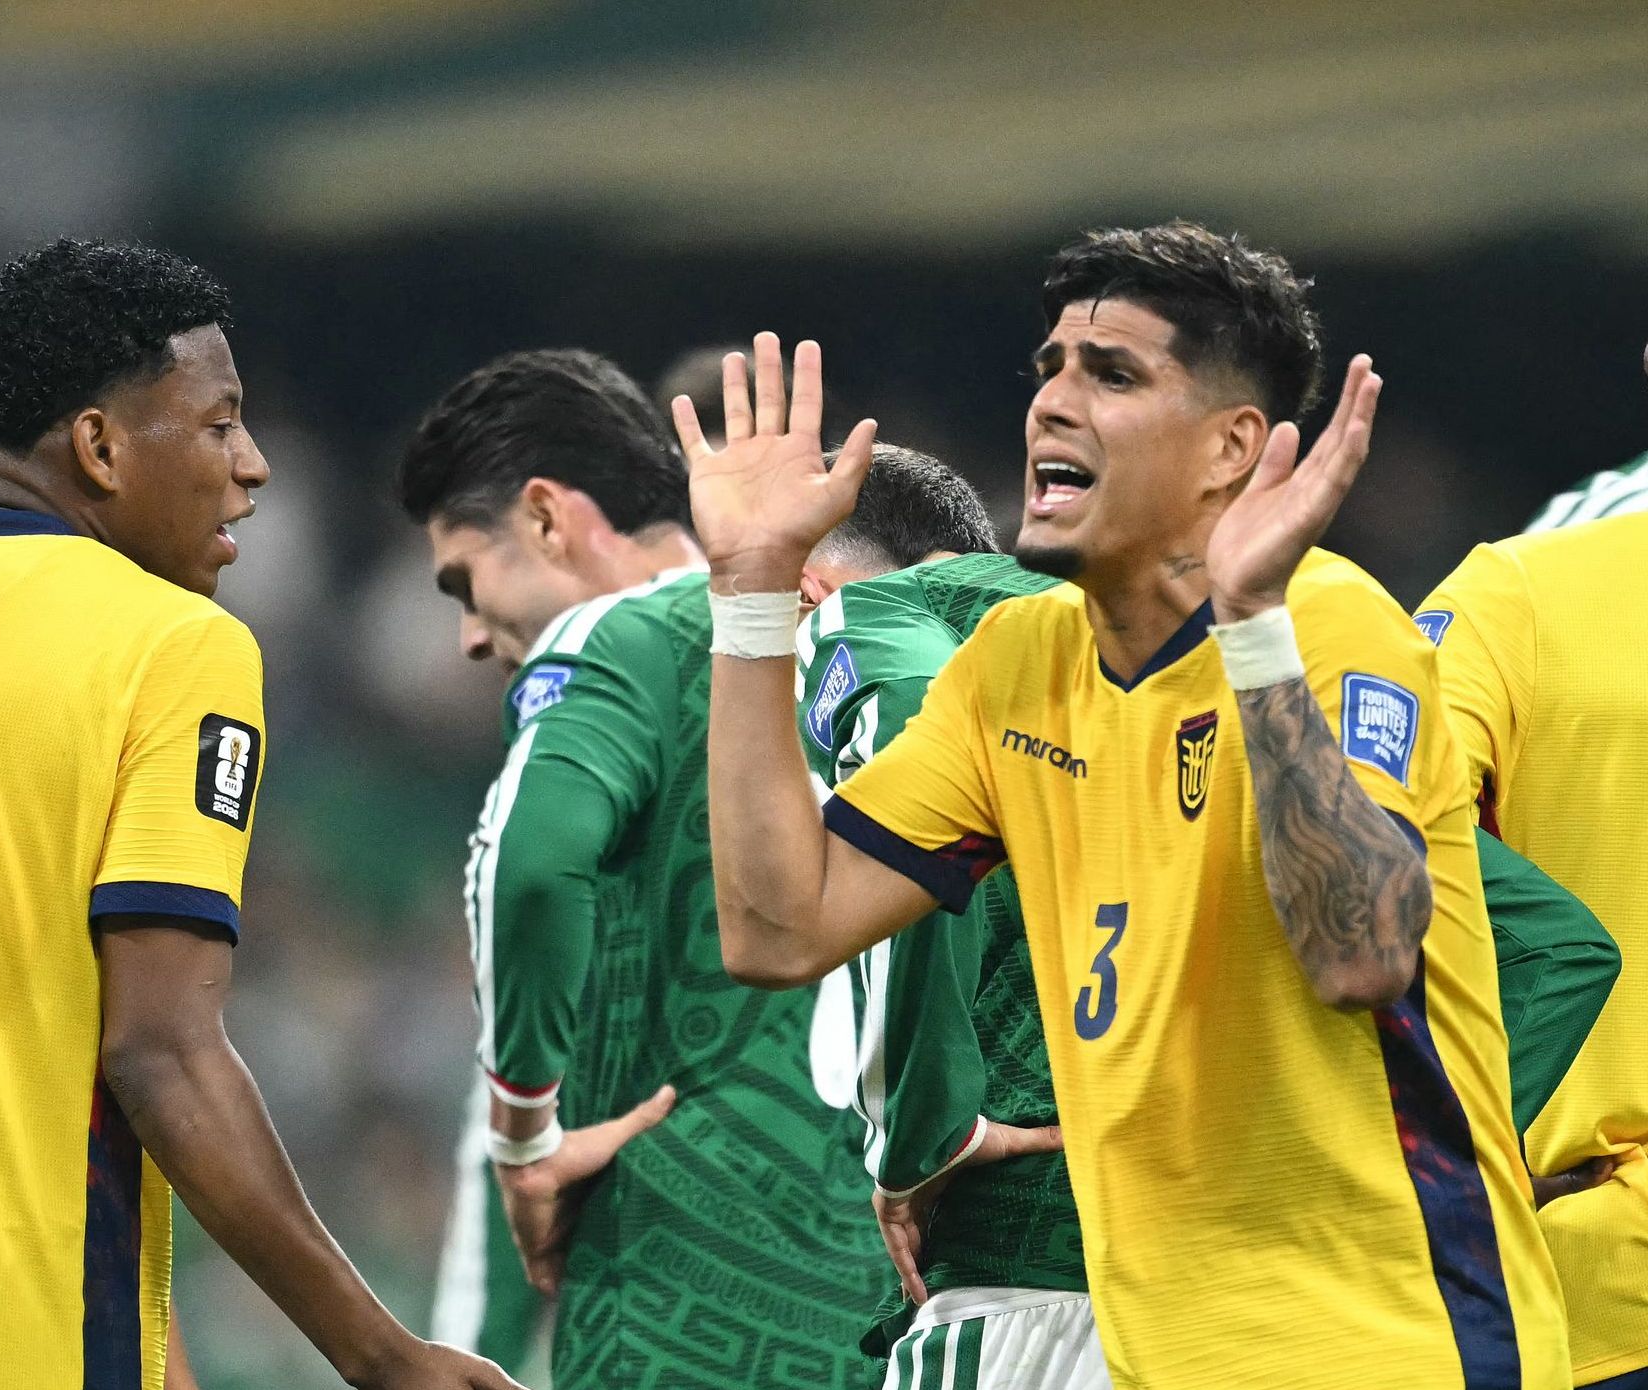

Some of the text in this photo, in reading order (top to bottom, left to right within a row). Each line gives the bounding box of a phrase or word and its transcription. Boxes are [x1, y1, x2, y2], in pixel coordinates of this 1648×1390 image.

[1358, 688, 1409, 720] FOOTBALL
[1358, 704, 1408, 742] UNITES
[213, 801, 238, 820] 2026
[1074, 901, 1130, 1042] 3
